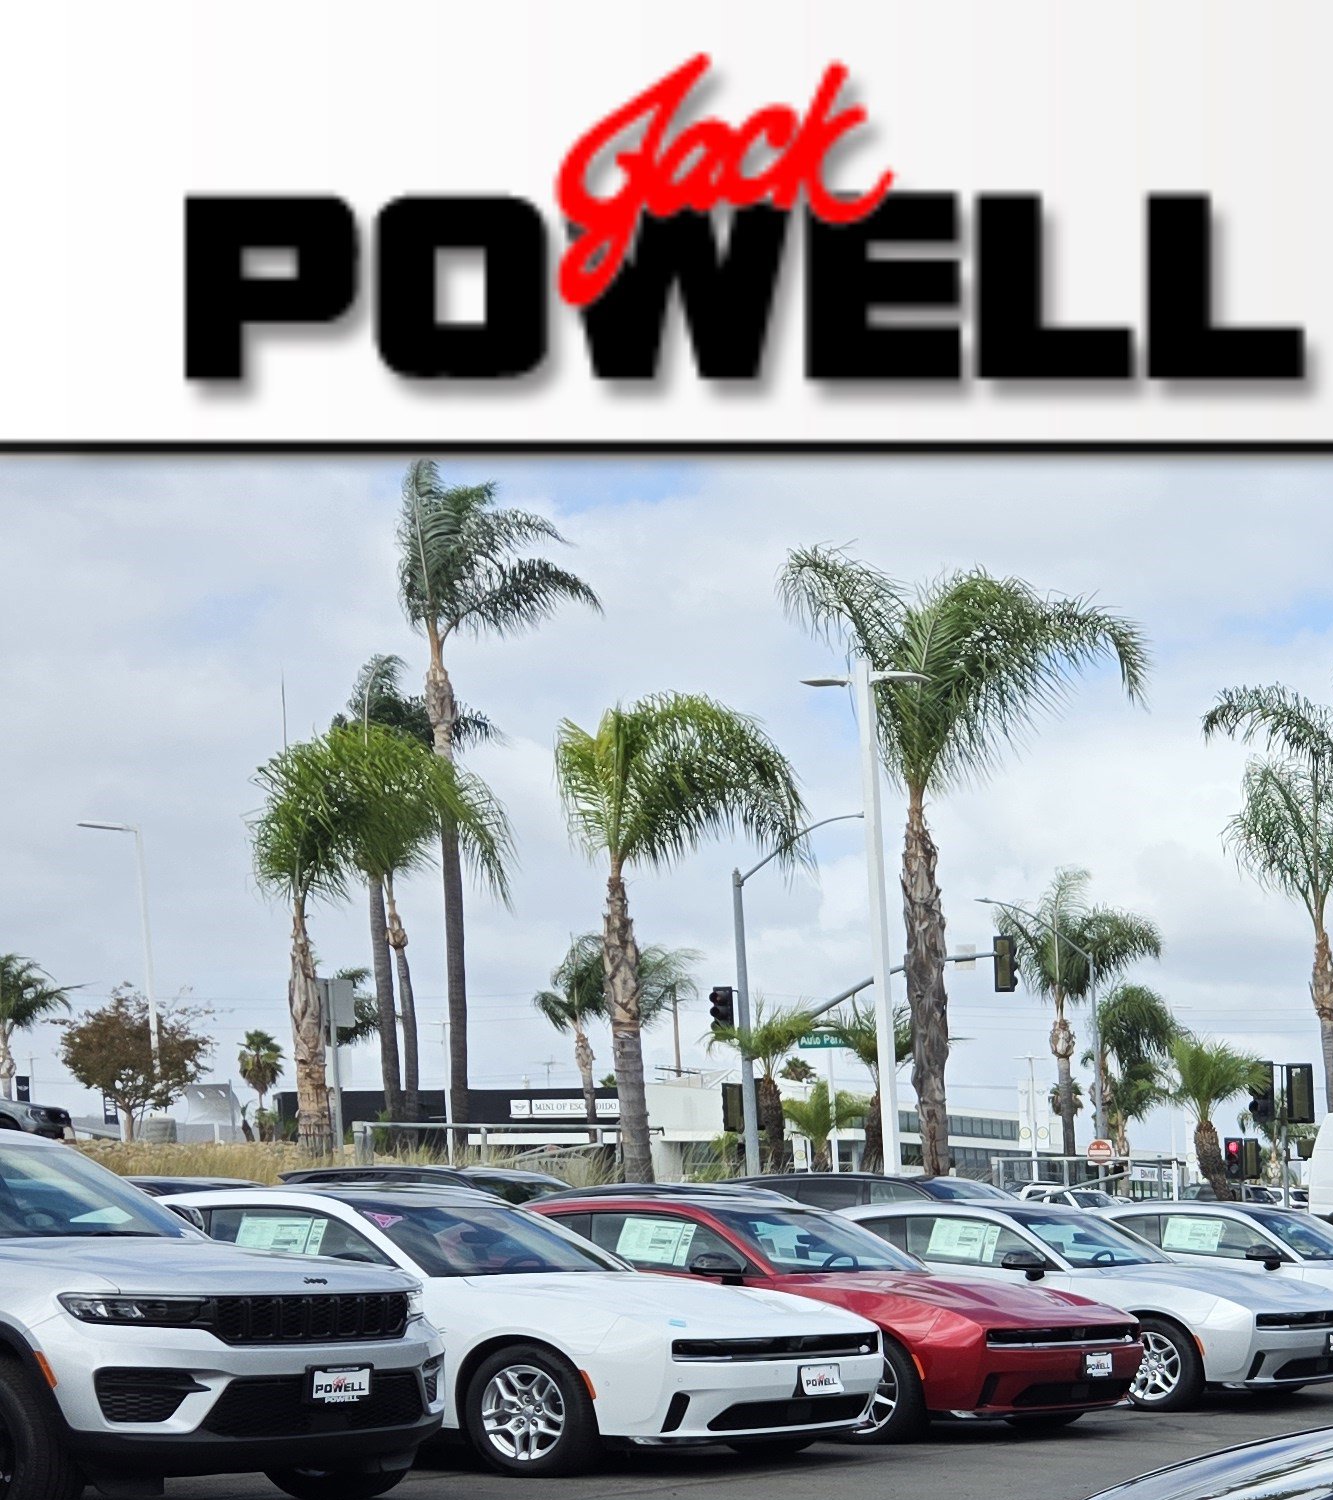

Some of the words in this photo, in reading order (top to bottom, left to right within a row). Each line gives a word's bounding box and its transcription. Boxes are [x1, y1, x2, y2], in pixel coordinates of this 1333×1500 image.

[800, 1034, 821, 1046] Auto
[534, 1103, 555, 1111] MINI
[556, 1103, 567, 1111] OF
[315, 1382, 366, 1394] POWELL
